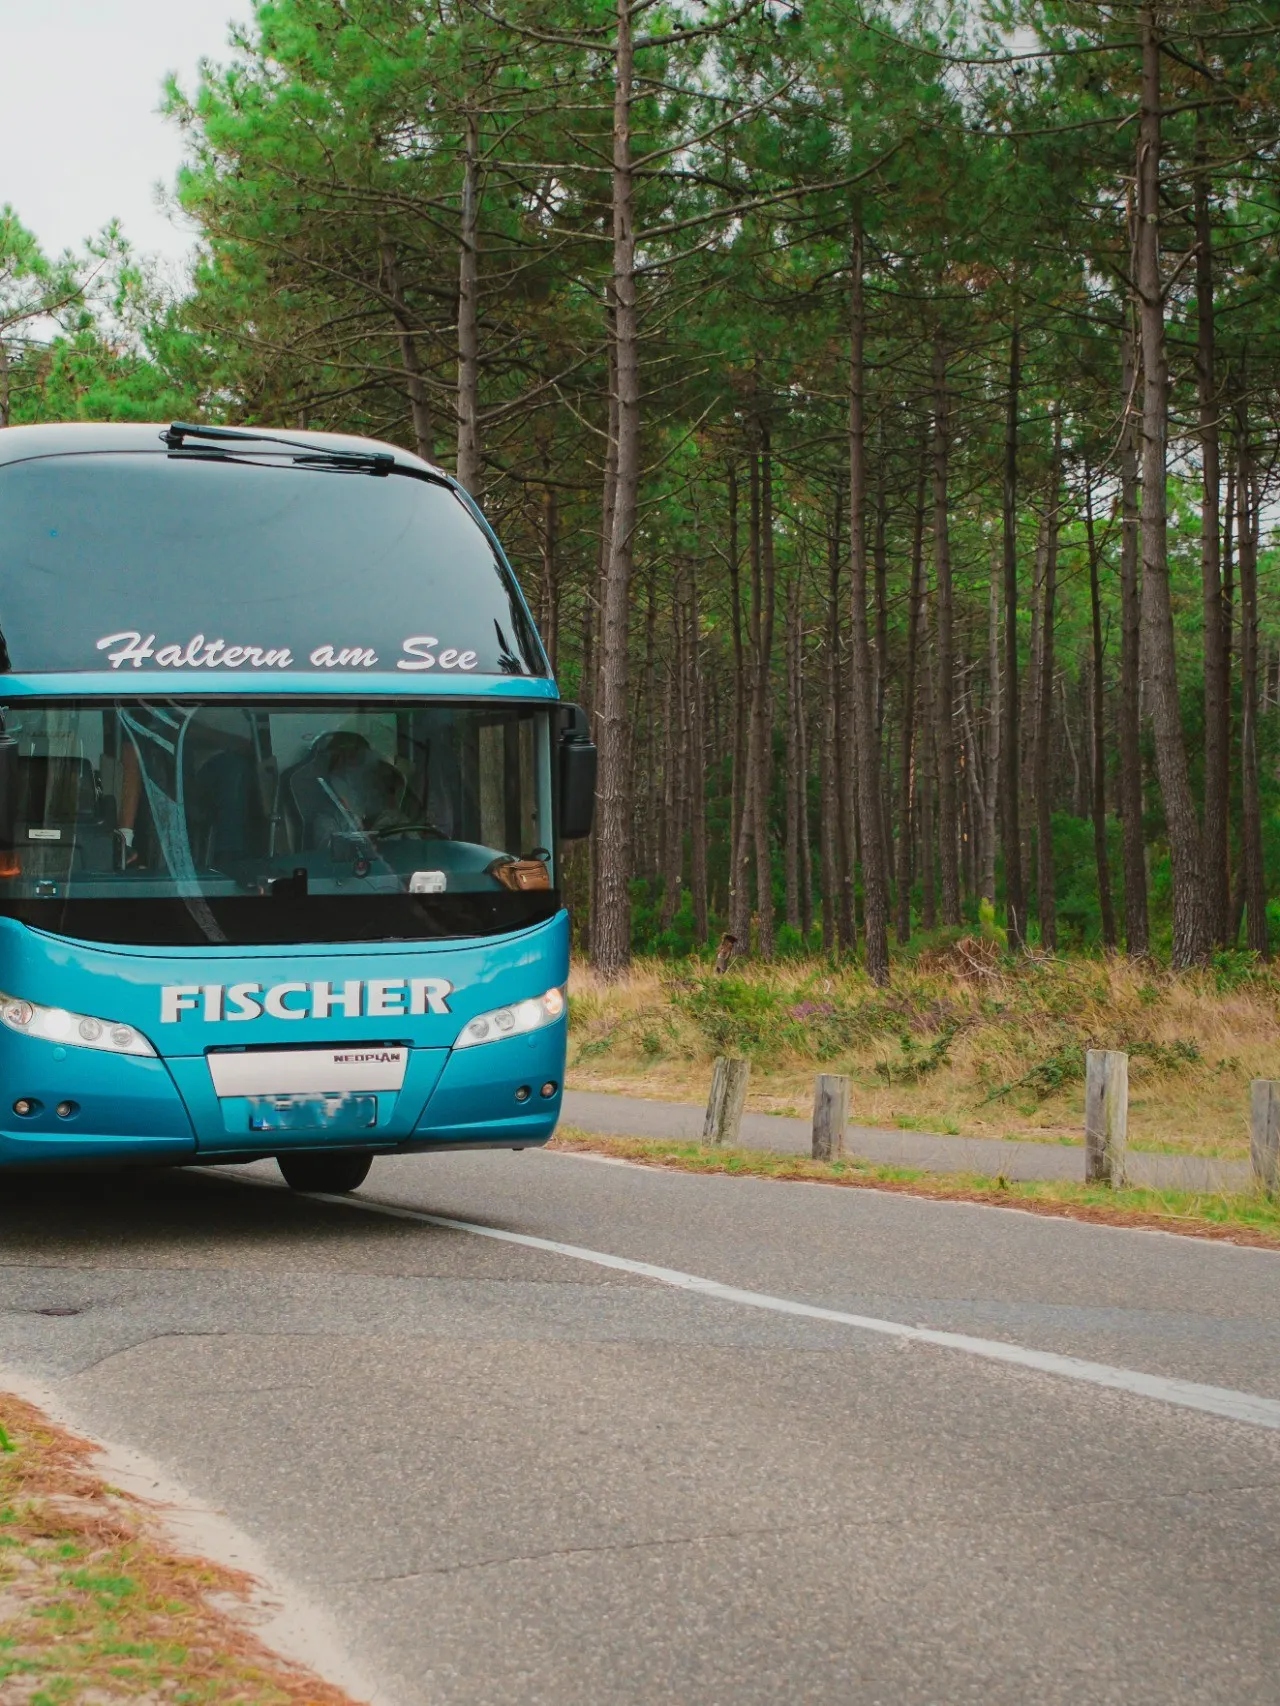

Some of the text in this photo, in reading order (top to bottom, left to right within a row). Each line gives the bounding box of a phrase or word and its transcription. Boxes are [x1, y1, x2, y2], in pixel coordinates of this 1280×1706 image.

[96, 631, 478, 670] Haltern am See
[160, 977, 454, 1024] FISCHER
[333, 1053, 400, 1064] NEOPLAN
